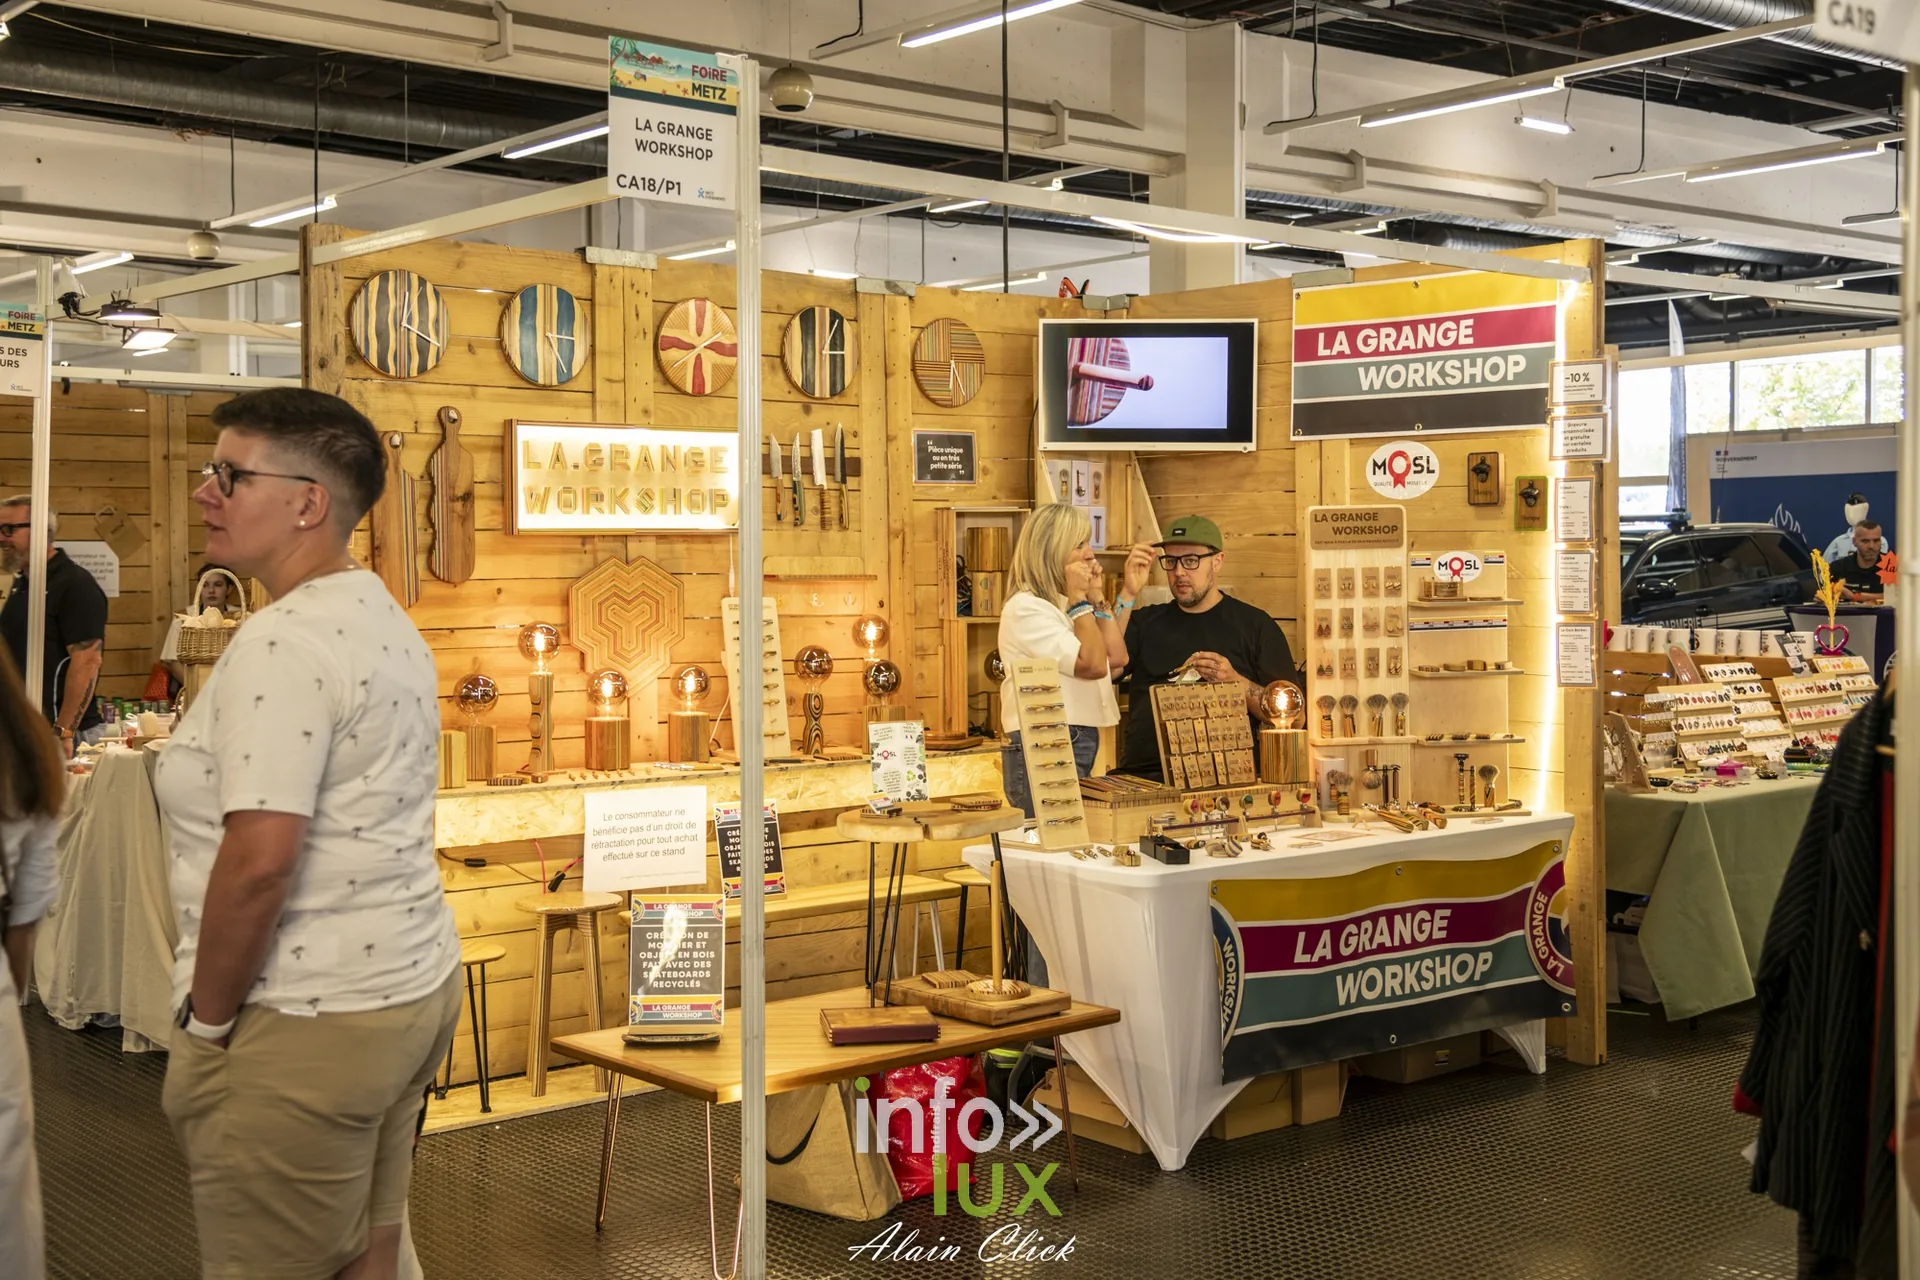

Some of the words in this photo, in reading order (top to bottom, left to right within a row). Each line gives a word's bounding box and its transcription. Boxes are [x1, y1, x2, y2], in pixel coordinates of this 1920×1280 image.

[692, 83, 727, 101] METZ
[636, 118, 652, 132] LA
[657, 121, 713, 141] GRANGE
[635, 138, 713, 161] WORKSHOP
[616, 174, 682, 196] CA18/P1
[8, 322, 35, 332] METZ
[1318, 331, 1351, 357] LA
[1356, 318, 1474, 354] GRANGE
[8, 347, 28, 357] DES
[1358, 354, 1526, 392] WORKSHOP
[1564, 373, 1580, 382] -10
[1582, 372, 1590, 382] %
[944, 446, 964, 454] unique
[930, 462, 947, 470] petite
[1372, 450, 1436, 477] MOSL
[523, 486, 730, 516] WORKSHOP
[1314, 513, 1328, 523] LA
[1330, 512, 1379, 522] GRANGE
[1332, 525, 1398, 535] WORKSHOP
[1438, 557, 1480, 572] MOSL
[1643, 616, 1700, 629] DARMERIE
[603, 813, 612, 821] Le
[615, 810, 672, 820] consommateur
[592, 825, 628, 836] bénéficie
[630, 826, 644, 836] pas
[665, 822, 683, 830] droit
[686, 821, 697, 829] de
[591, 838, 635, 849] rétractation
[636, 838, 655, 847] pour
[674, 834, 698, 842] achat
[602, 852, 634, 862] effectué
[662, 847, 685, 856] stand
[1532, 891, 1549, 959] GRANGE
[646, 930, 694, 939] CRÉON
[1294, 931, 1332, 964] LA
[1339, 908, 1452, 956] GRANGE
[1547, 956, 1564, 978] LA
[653, 979, 700, 988] RECYCLÉS
[1336, 951, 1492, 1006] WORKSHOP
